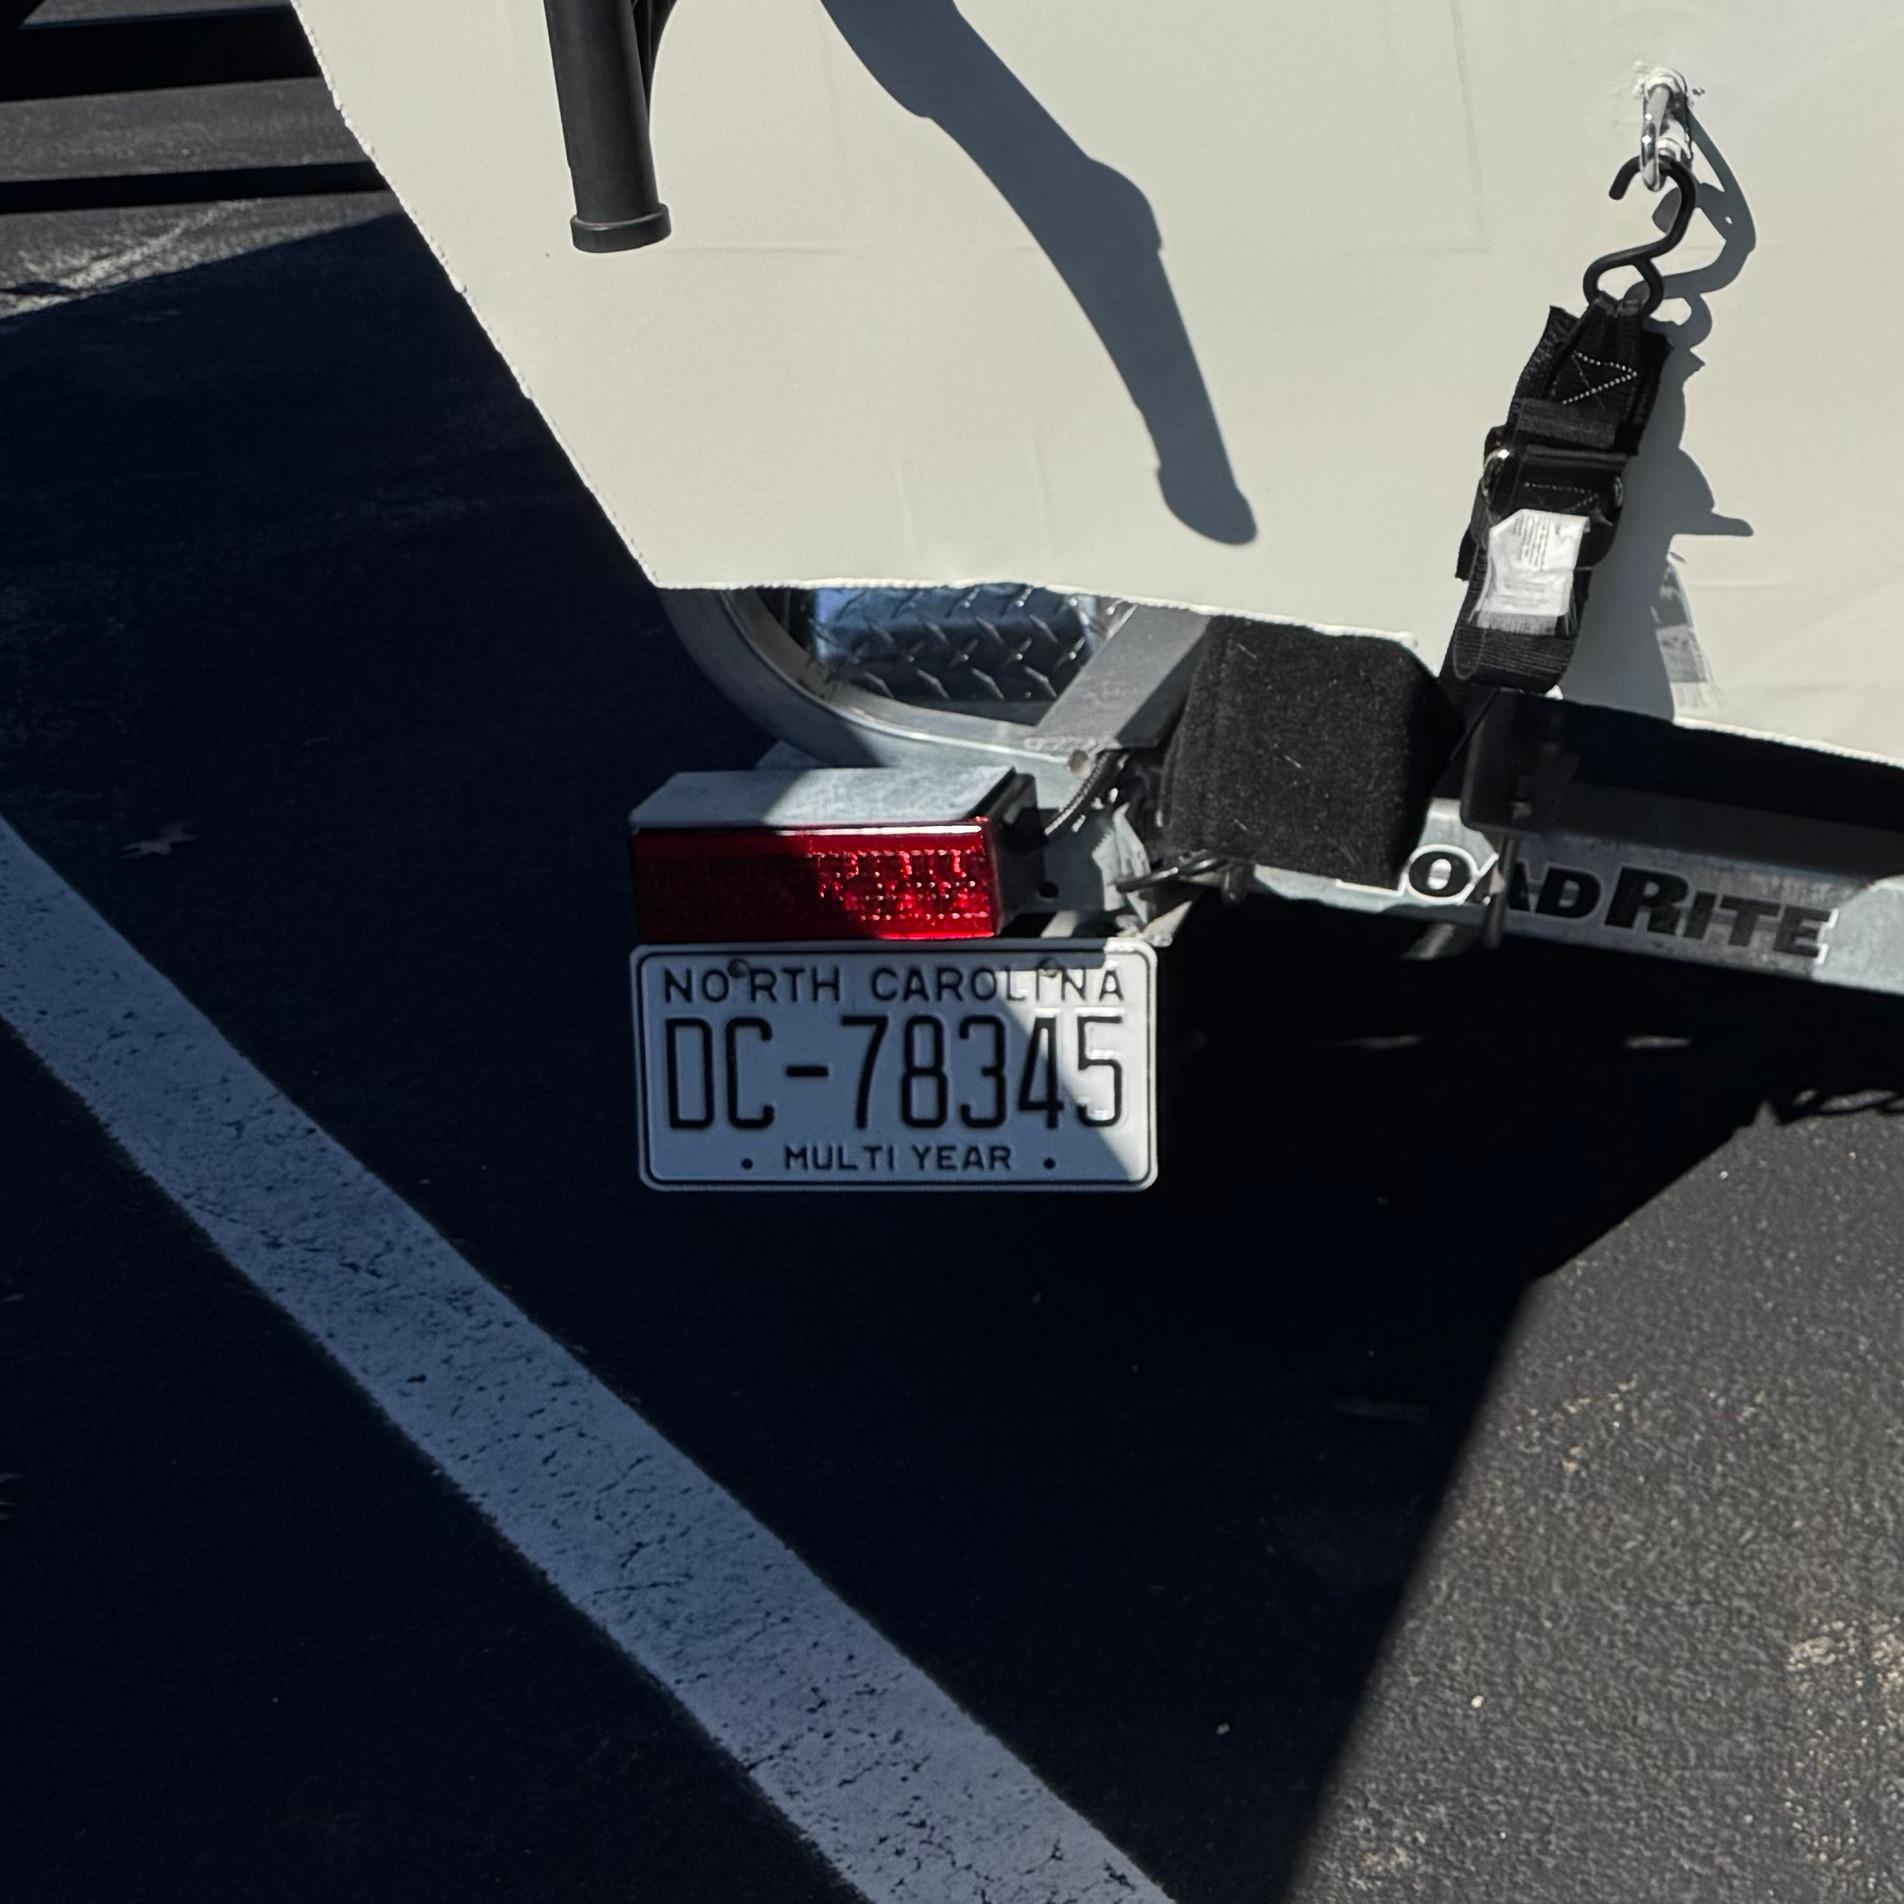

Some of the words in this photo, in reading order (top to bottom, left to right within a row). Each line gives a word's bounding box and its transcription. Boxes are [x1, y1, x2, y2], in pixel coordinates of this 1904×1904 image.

[664, 967, 841, 1004] NORTH
[870, 966, 1124, 1003] CAROLINA
[665, 1014, 1124, 1131] DC-78345
[785, 1144, 895, 1171] MULTI
[910, 1144, 1011, 1171] YEAR
